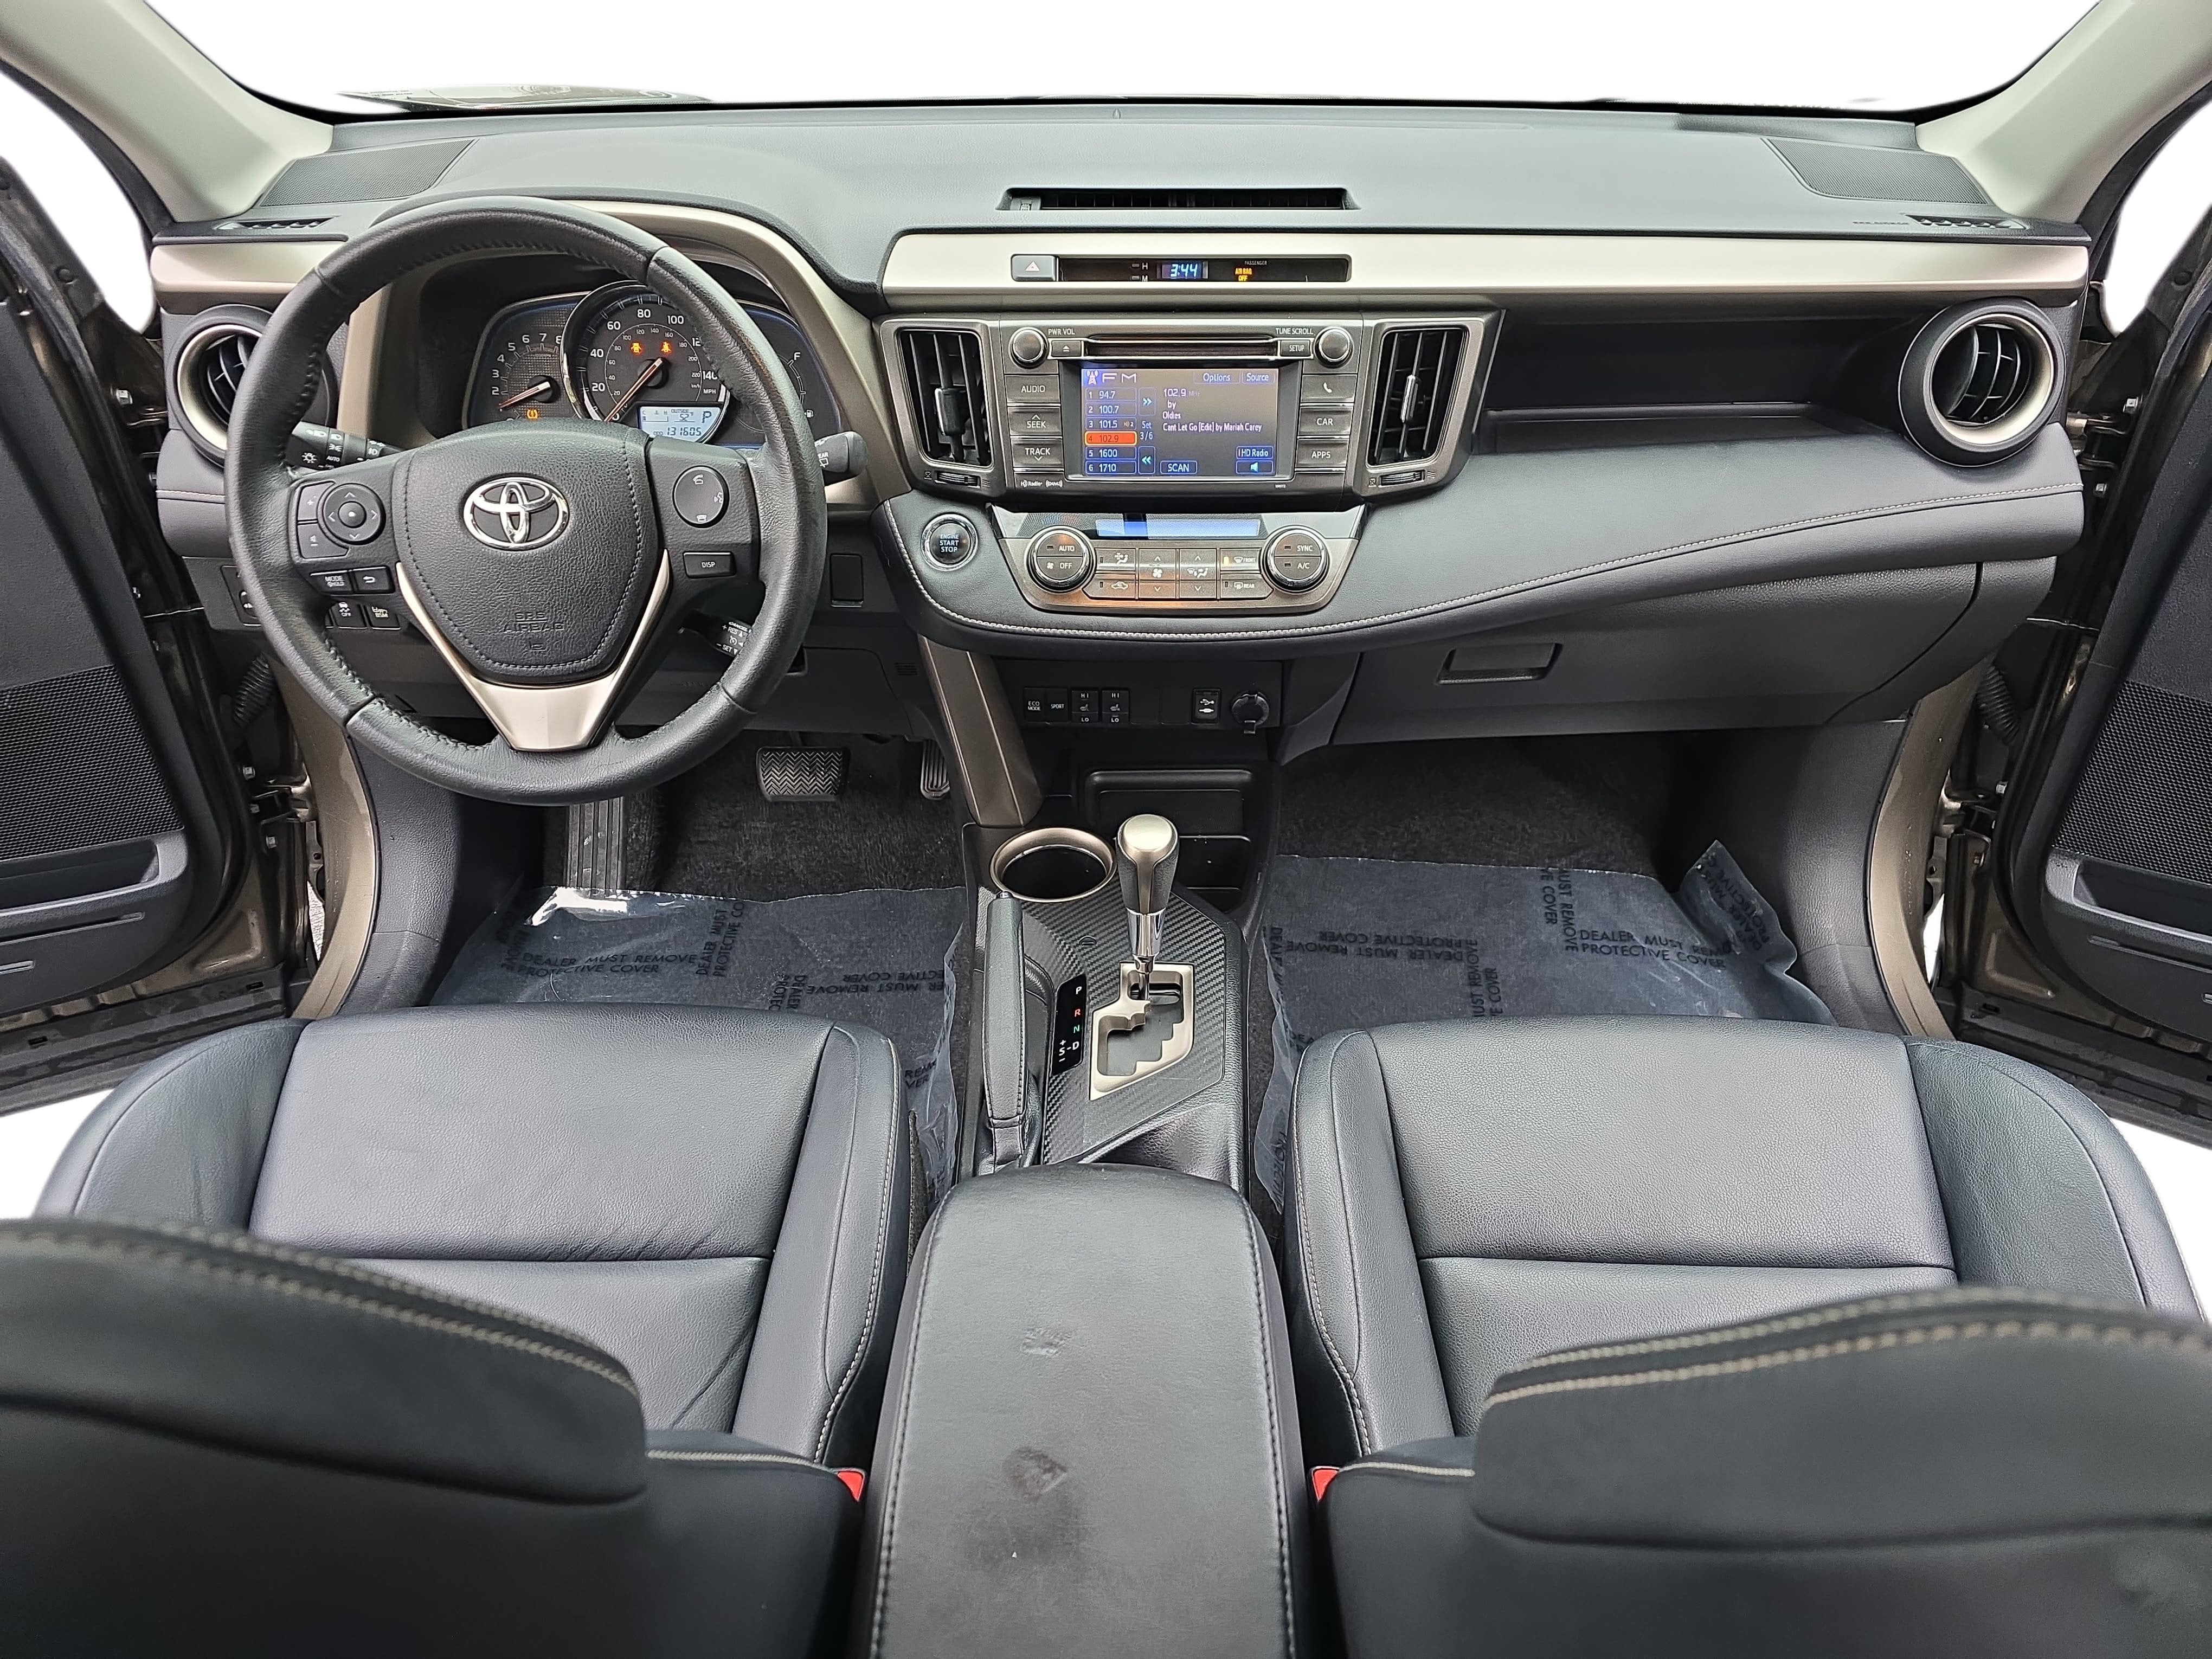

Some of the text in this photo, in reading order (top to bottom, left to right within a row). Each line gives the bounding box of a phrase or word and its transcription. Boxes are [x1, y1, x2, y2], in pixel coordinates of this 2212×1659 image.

[1170, 263, 1198, 278] 3:44
[637, 308, 651, 318] 80
[667, 315, 684, 324] 100
[607, 321, 621, 330] 60
[522, 335, 530, 343] 6
[539, 333, 547, 342] 7
[507, 342, 516, 351] 5
[1289, 344, 1305, 352] SETUP
[590, 348, 604, 358] 40
[794, 352, 801, 361] F
[497, 353, 505, 363] 4
[492, 369, 499, 378] 3
[1203, 372, 1231, 383] Options
[1246, 372, 1270, 382] Source
[491, 387, 499, 395] 2
[591, 382, 606, 392] 20
[1021, 385, 1046, 393] AUDIO
[1099, 390, 1116, 399] 94.7
[1163, 388, 1187, 397] 102.9
[1167, 400, 1176, 409] by
[1099, 405, 1120, 414] 100.7
[702, 410, 712, 423] P
[1162, 411, 1181, 420] Oldies
[1099, 420, 1118, 428] 101.5
[1142, 420, 1152, 429] Set
[1316, 417, 1334, 426] CAR
[667, 427, 702, 436] 131605
[1215, 423, 1223, 432] by
[1245, 422, 1262, 432] Carey
[1099, 435, 1119, 443] 102.9
[1140, 432, 1153, 441] 3/6
[1099, 449, 1118, 458] 1600
[1252, 449, 1269, 457] Radio
[1099, 464, 1117, 472] 1710
[1168, 464, 1189, 472] SCAN
[728, 627, 738, 635] RES
[722, 645, 733, 653] SET
[1542, 886, 1558, 925] COVER
[1560, 903, 1579, 953] REMOVE
[1319, 930, 1463, 949] PROTECTIVE COVER
[1579, 929, 1636, 942] DEALER
[1644, 934, 1683, 951] MUST
[1285, 940, 1465, 962] DEALER MUST REMOVE
[522, 952, 698, 967] DEALER MUST REMOVE
[1580, 942, 1727, 971] PROTECTIVE COVER
[1465, 938, 1485, 987] REMOVE
[517, 963, 660, 976] PROTECTIVE COVER
[842, 971, 892, 982] COVER
[806, 983, 871, 994] REMOVE
[876, 982, 921, 993] MUST
[1483, 967, 1503, 1004] COVER
[1075, 986, 1083, 995] P
[1074, 1008, 1082, 1018] R
[1073, 1025, 1081, 1033] N
